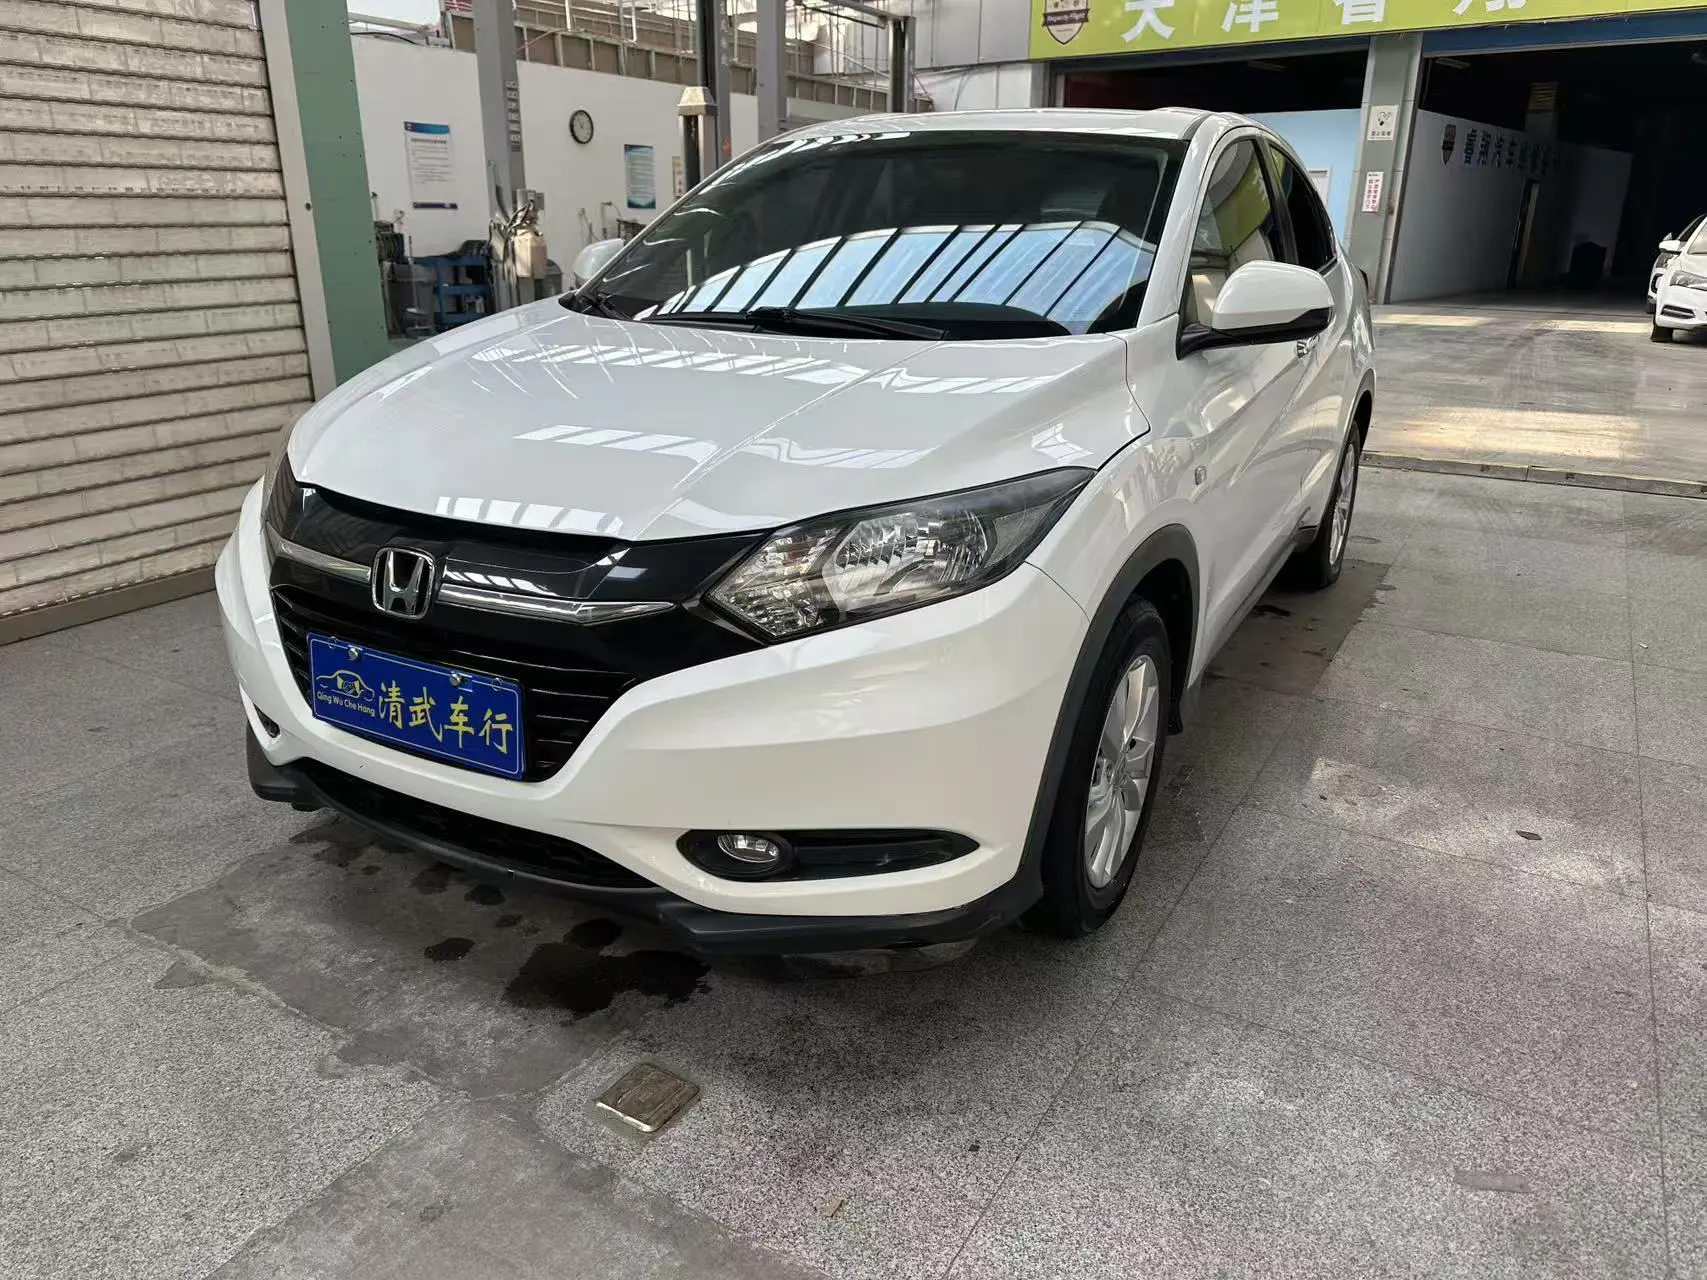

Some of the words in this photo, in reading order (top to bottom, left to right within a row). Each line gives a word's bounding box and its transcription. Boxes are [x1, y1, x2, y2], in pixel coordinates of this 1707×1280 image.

[317, 691, 332, 704] Qing
[332, 696, 344, 706] Wu
[344, 699, 357, 710] Che
[357, 704, 376, 717] Hang
[378, 680, 513, 754] 清武车行
